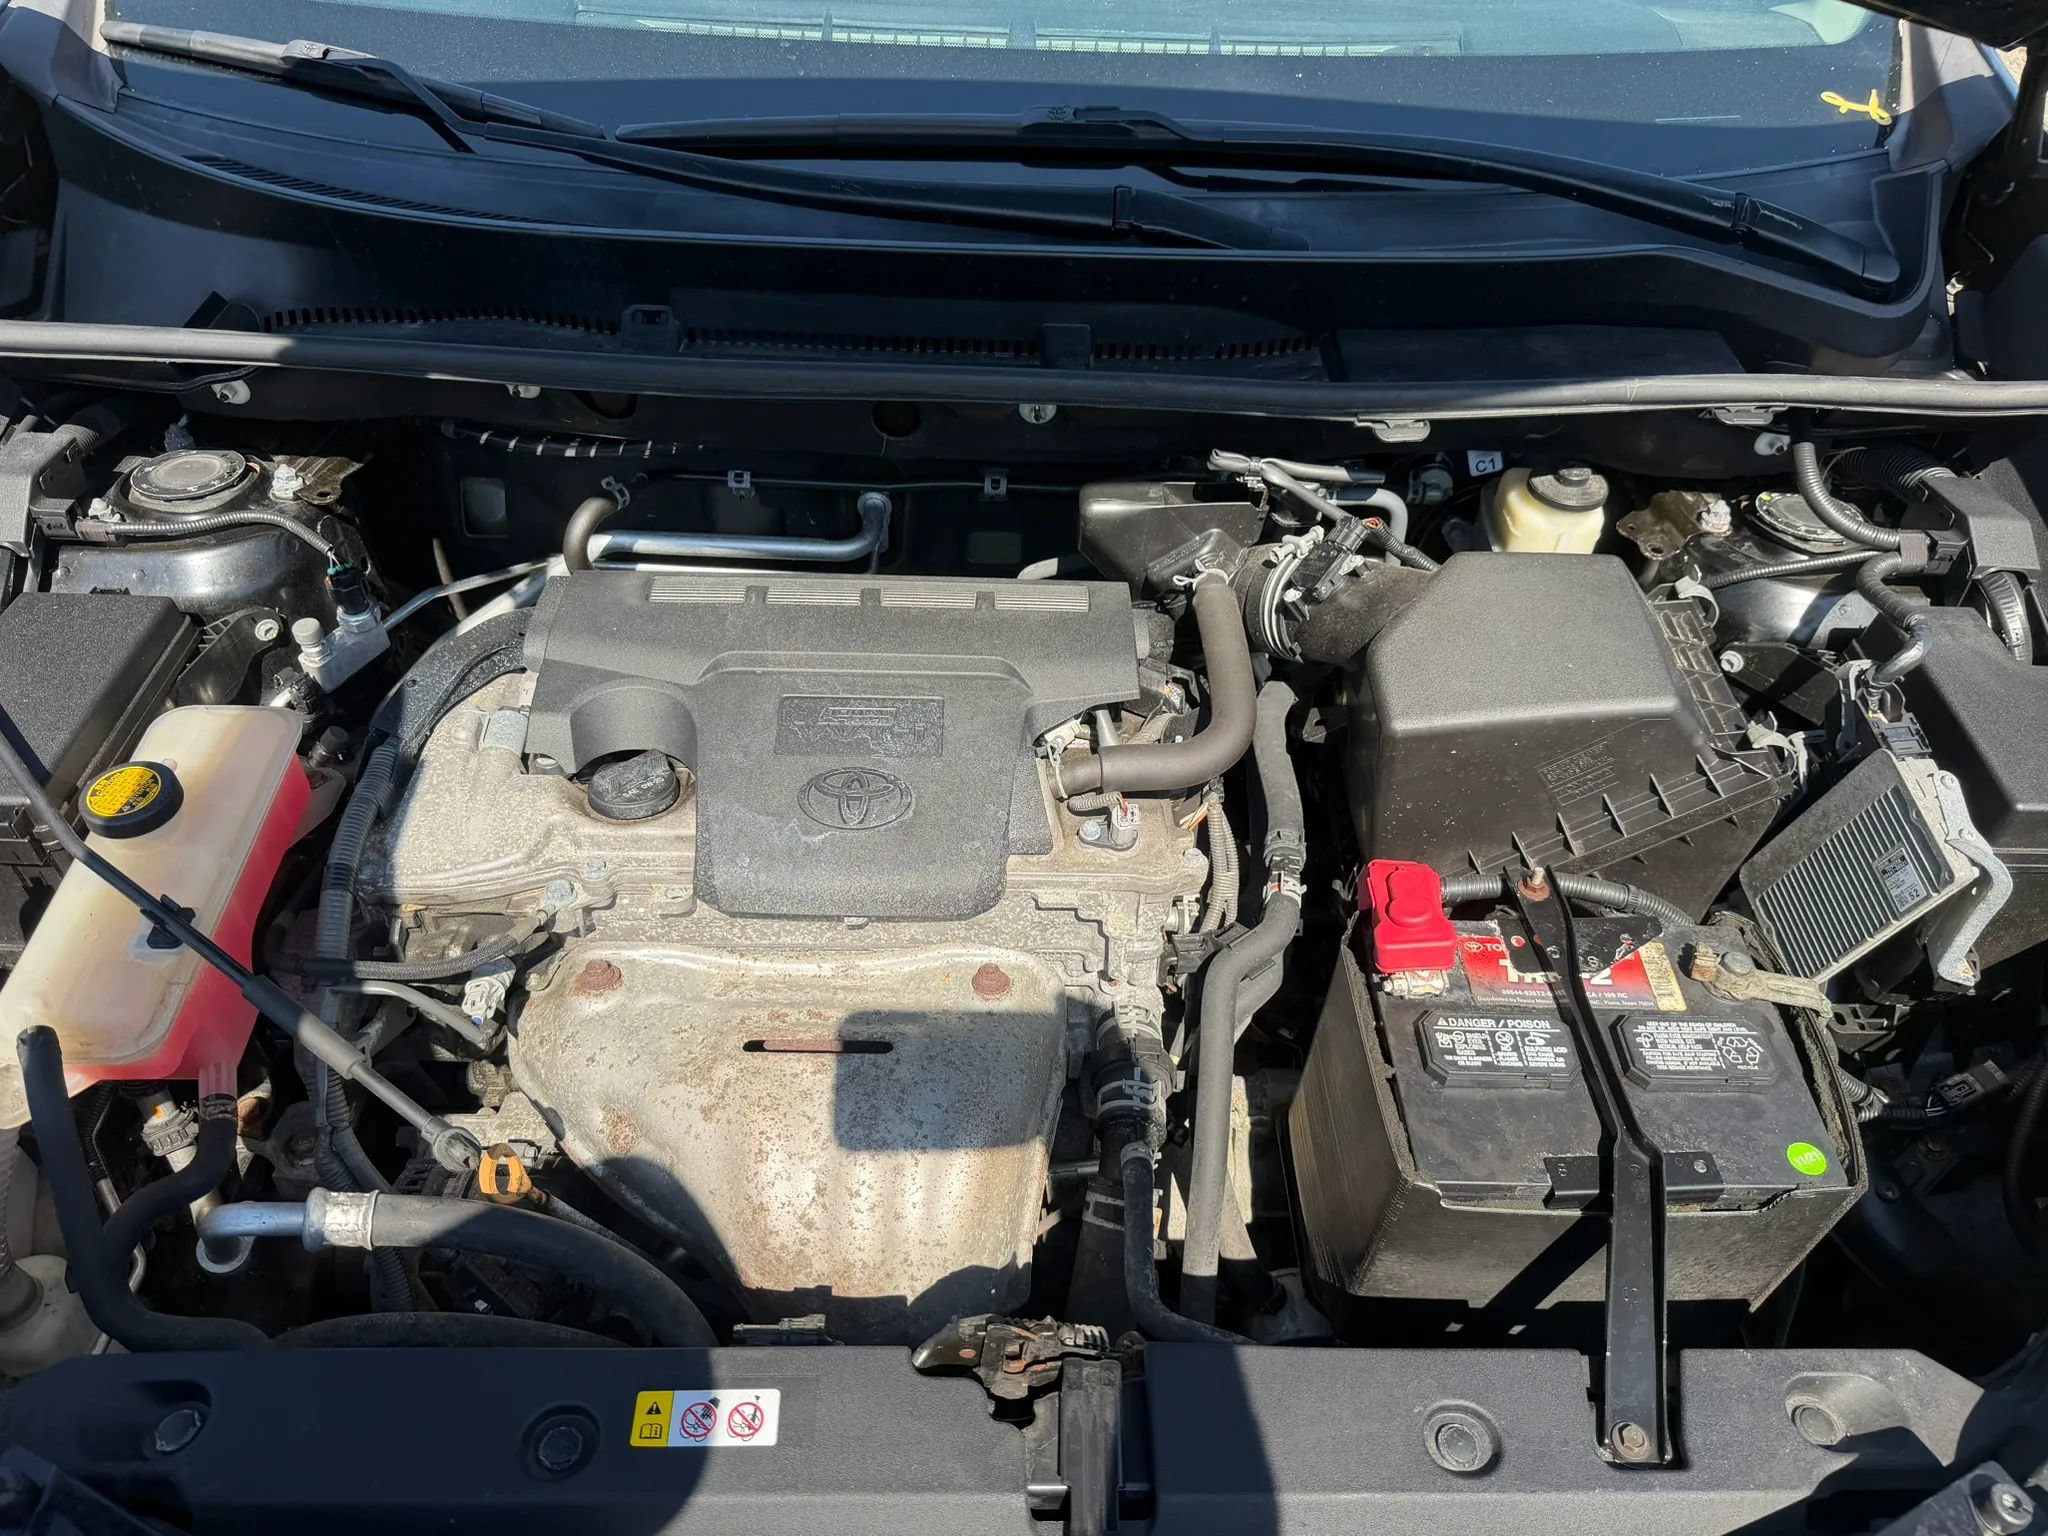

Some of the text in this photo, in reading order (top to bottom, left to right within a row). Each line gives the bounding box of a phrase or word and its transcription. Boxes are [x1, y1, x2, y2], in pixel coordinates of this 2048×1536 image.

[1475, 457, 1496, 473] C1
[1909, 889, 1920, 901] 52
[1447, 1018, 1551, 1029] DANGER / POISON
